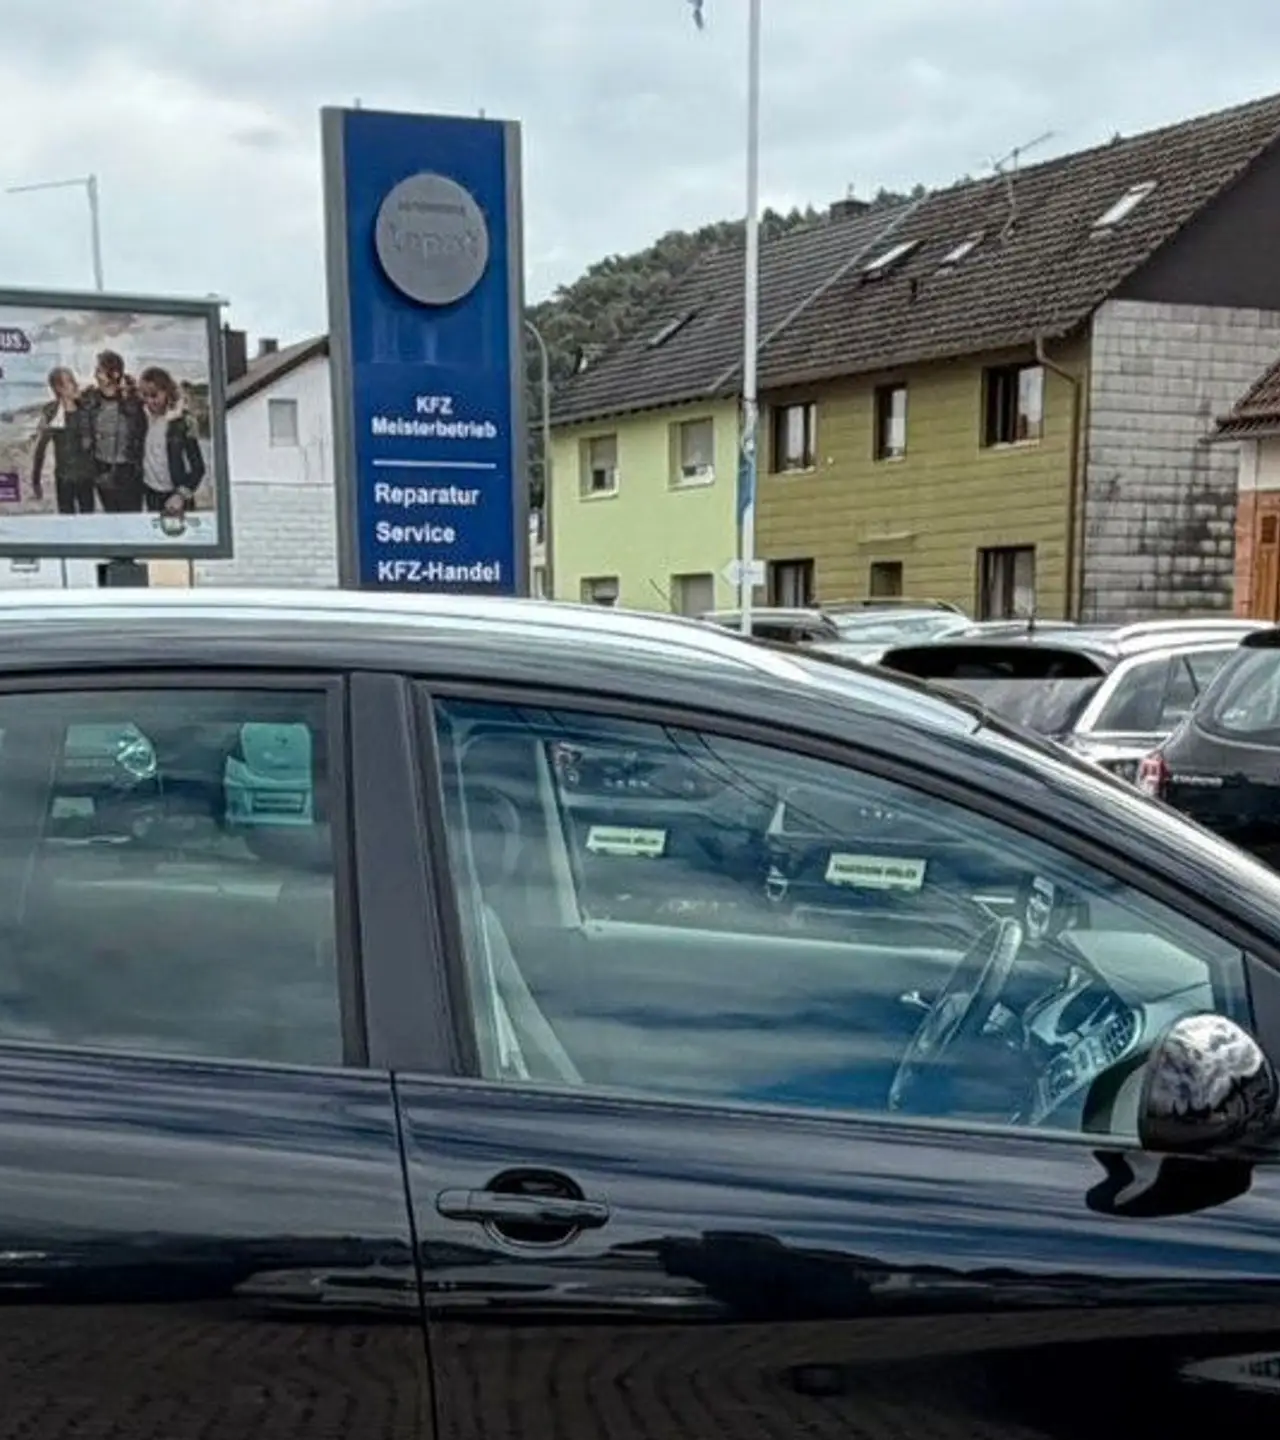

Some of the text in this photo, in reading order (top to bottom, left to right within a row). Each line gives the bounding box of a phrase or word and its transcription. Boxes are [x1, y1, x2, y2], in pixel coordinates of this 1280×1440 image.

[416, 396, 453, 414] KFZ
[372, 416, 497, 438] Meisterbetrieb
[375, 482, 480, 509] Reparatur
[376, 520, 456, 543] Service
[378, 560, 500, 583] KFZ-Handel
